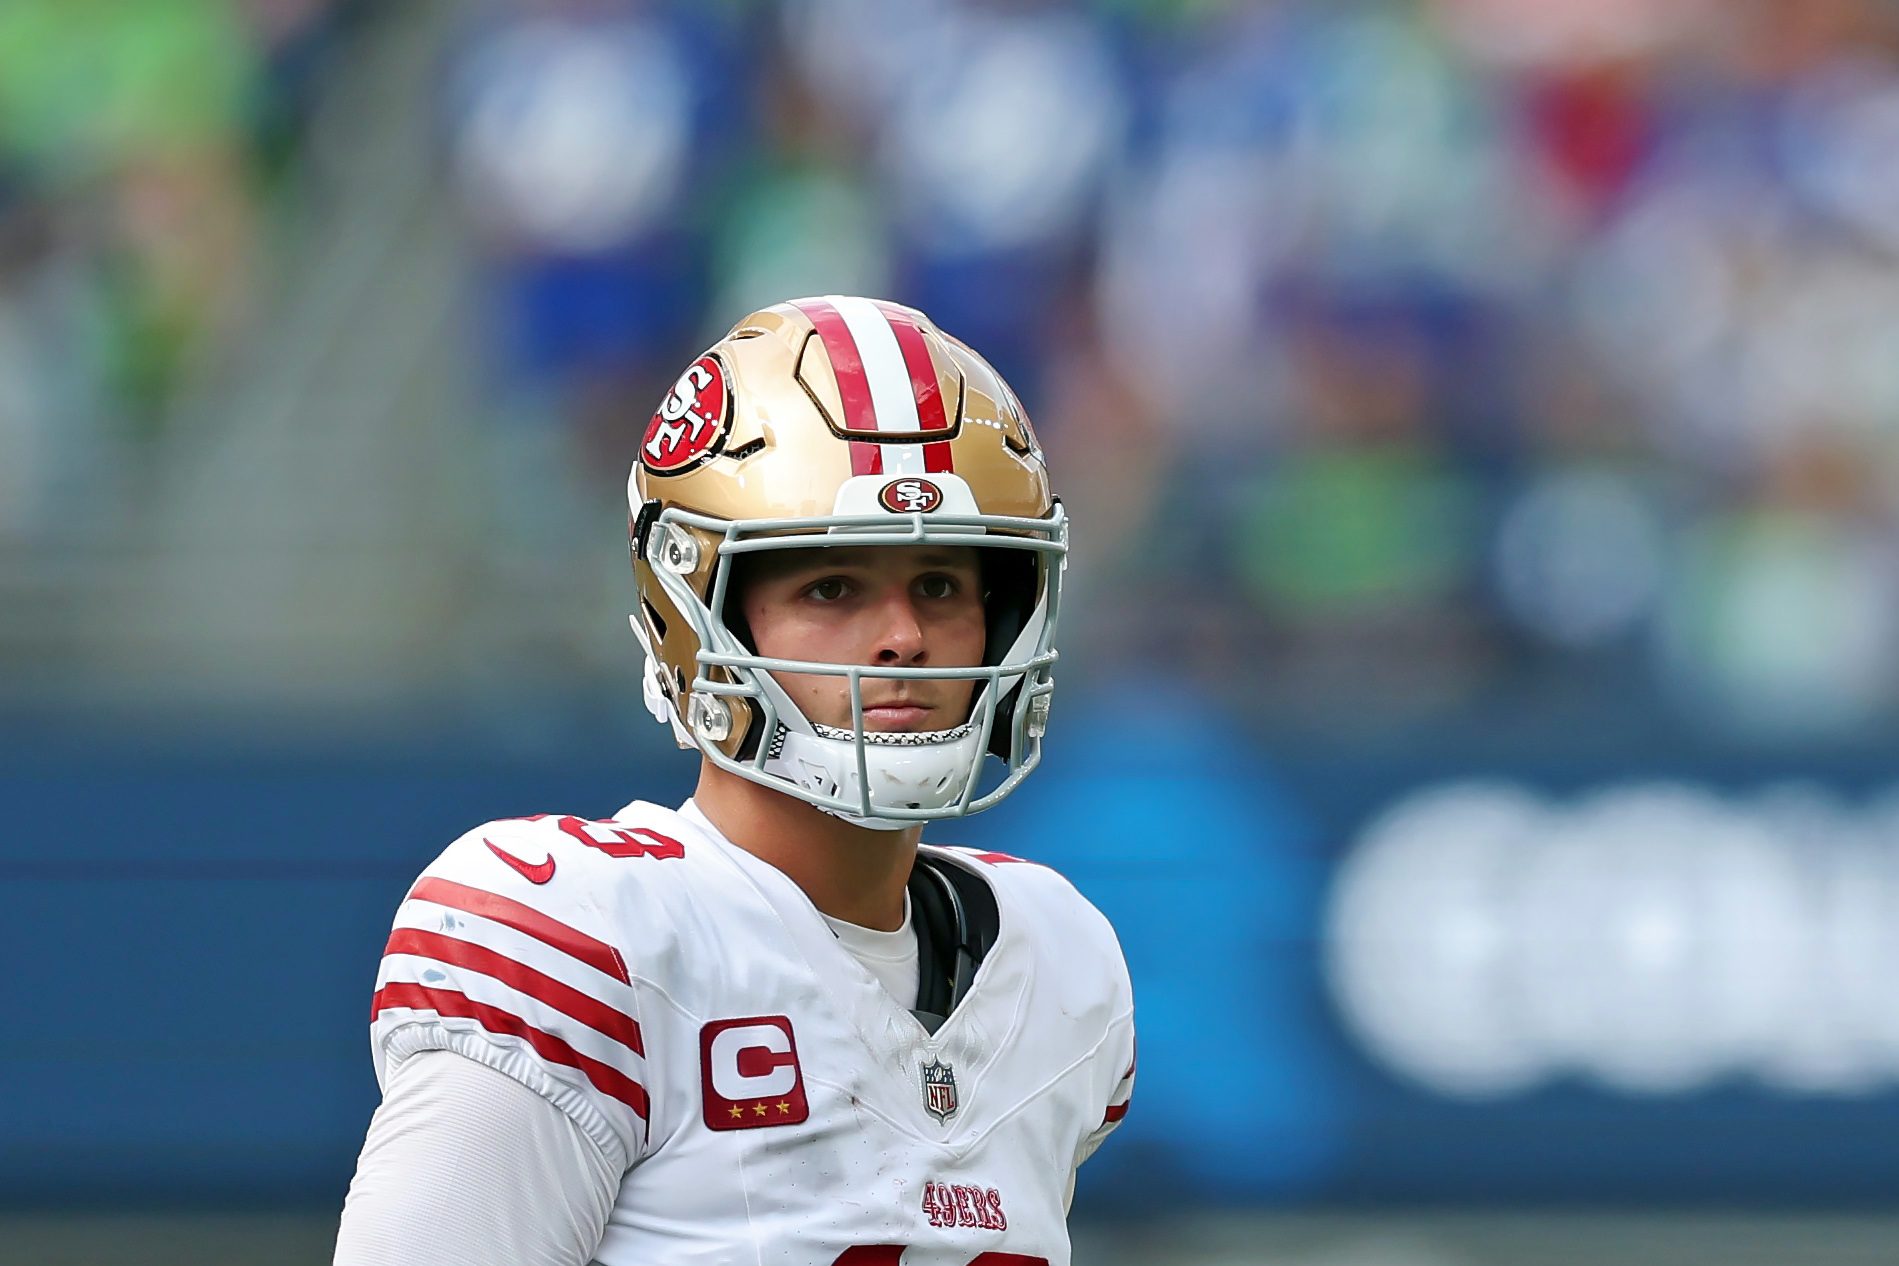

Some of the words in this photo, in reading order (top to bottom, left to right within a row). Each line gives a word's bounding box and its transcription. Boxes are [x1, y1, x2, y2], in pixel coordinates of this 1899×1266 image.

[896, 481, 934, 511] SF
[710, 1024, 797, 1101] C
[928, 1085, 955, 1112] NFL
[922, 1181, 1007, 1231] 49ERS
